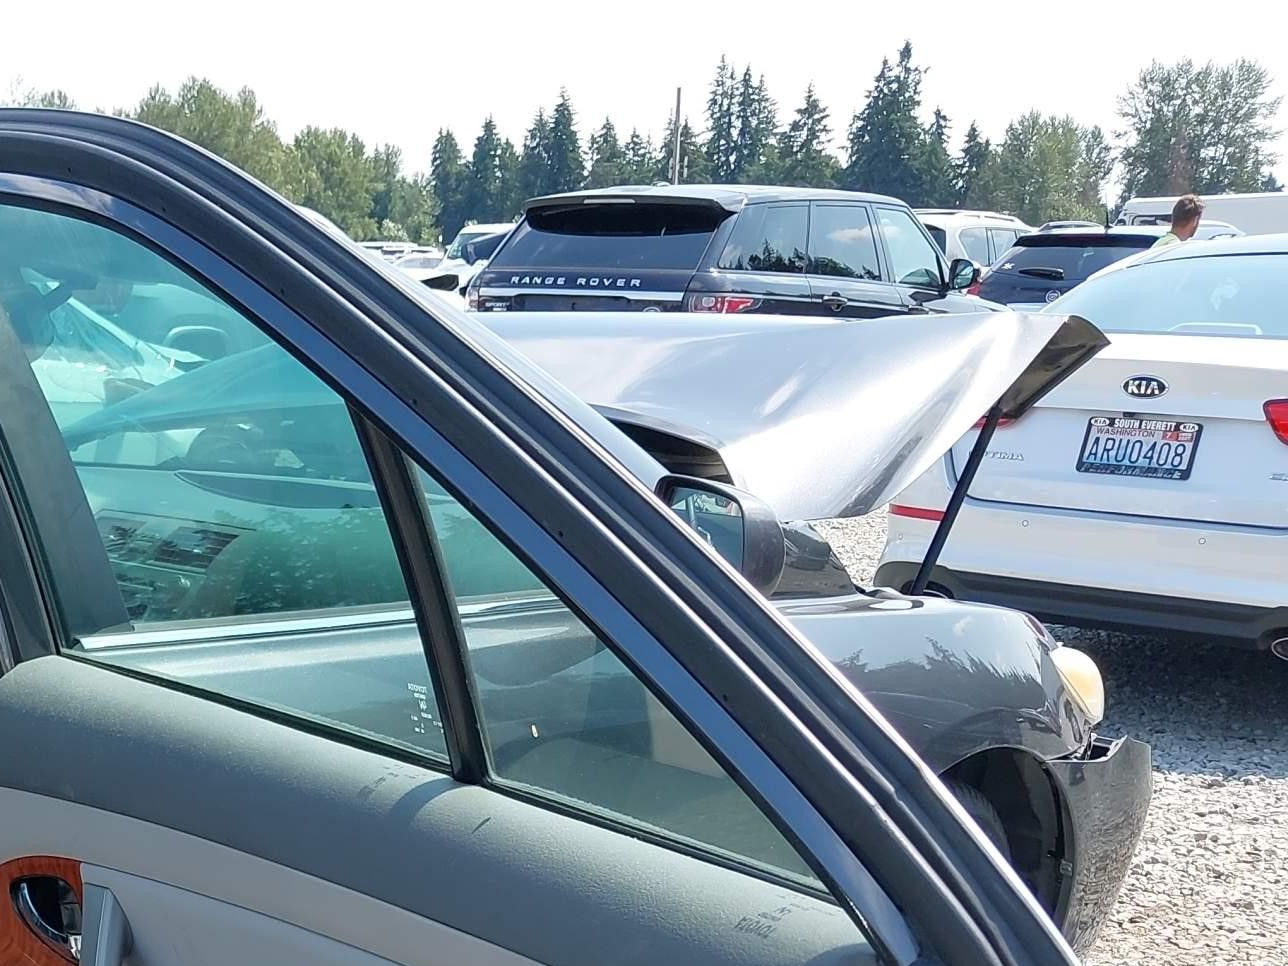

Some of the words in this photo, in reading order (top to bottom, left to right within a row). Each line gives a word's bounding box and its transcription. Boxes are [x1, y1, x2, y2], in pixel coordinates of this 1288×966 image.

[511, 276, 566, 285] RANGE
[576, 277, 641, 287] ROVER
[1127, 380, 1160, 395] KIA
[1114, 419, 1140, 429] SOUTH
[1141, 420, 1176, 431] EVERETT
[1096, 427, 1156, 438] WASHINGTON
[1086, 436, 1187, 468] ARU0408
